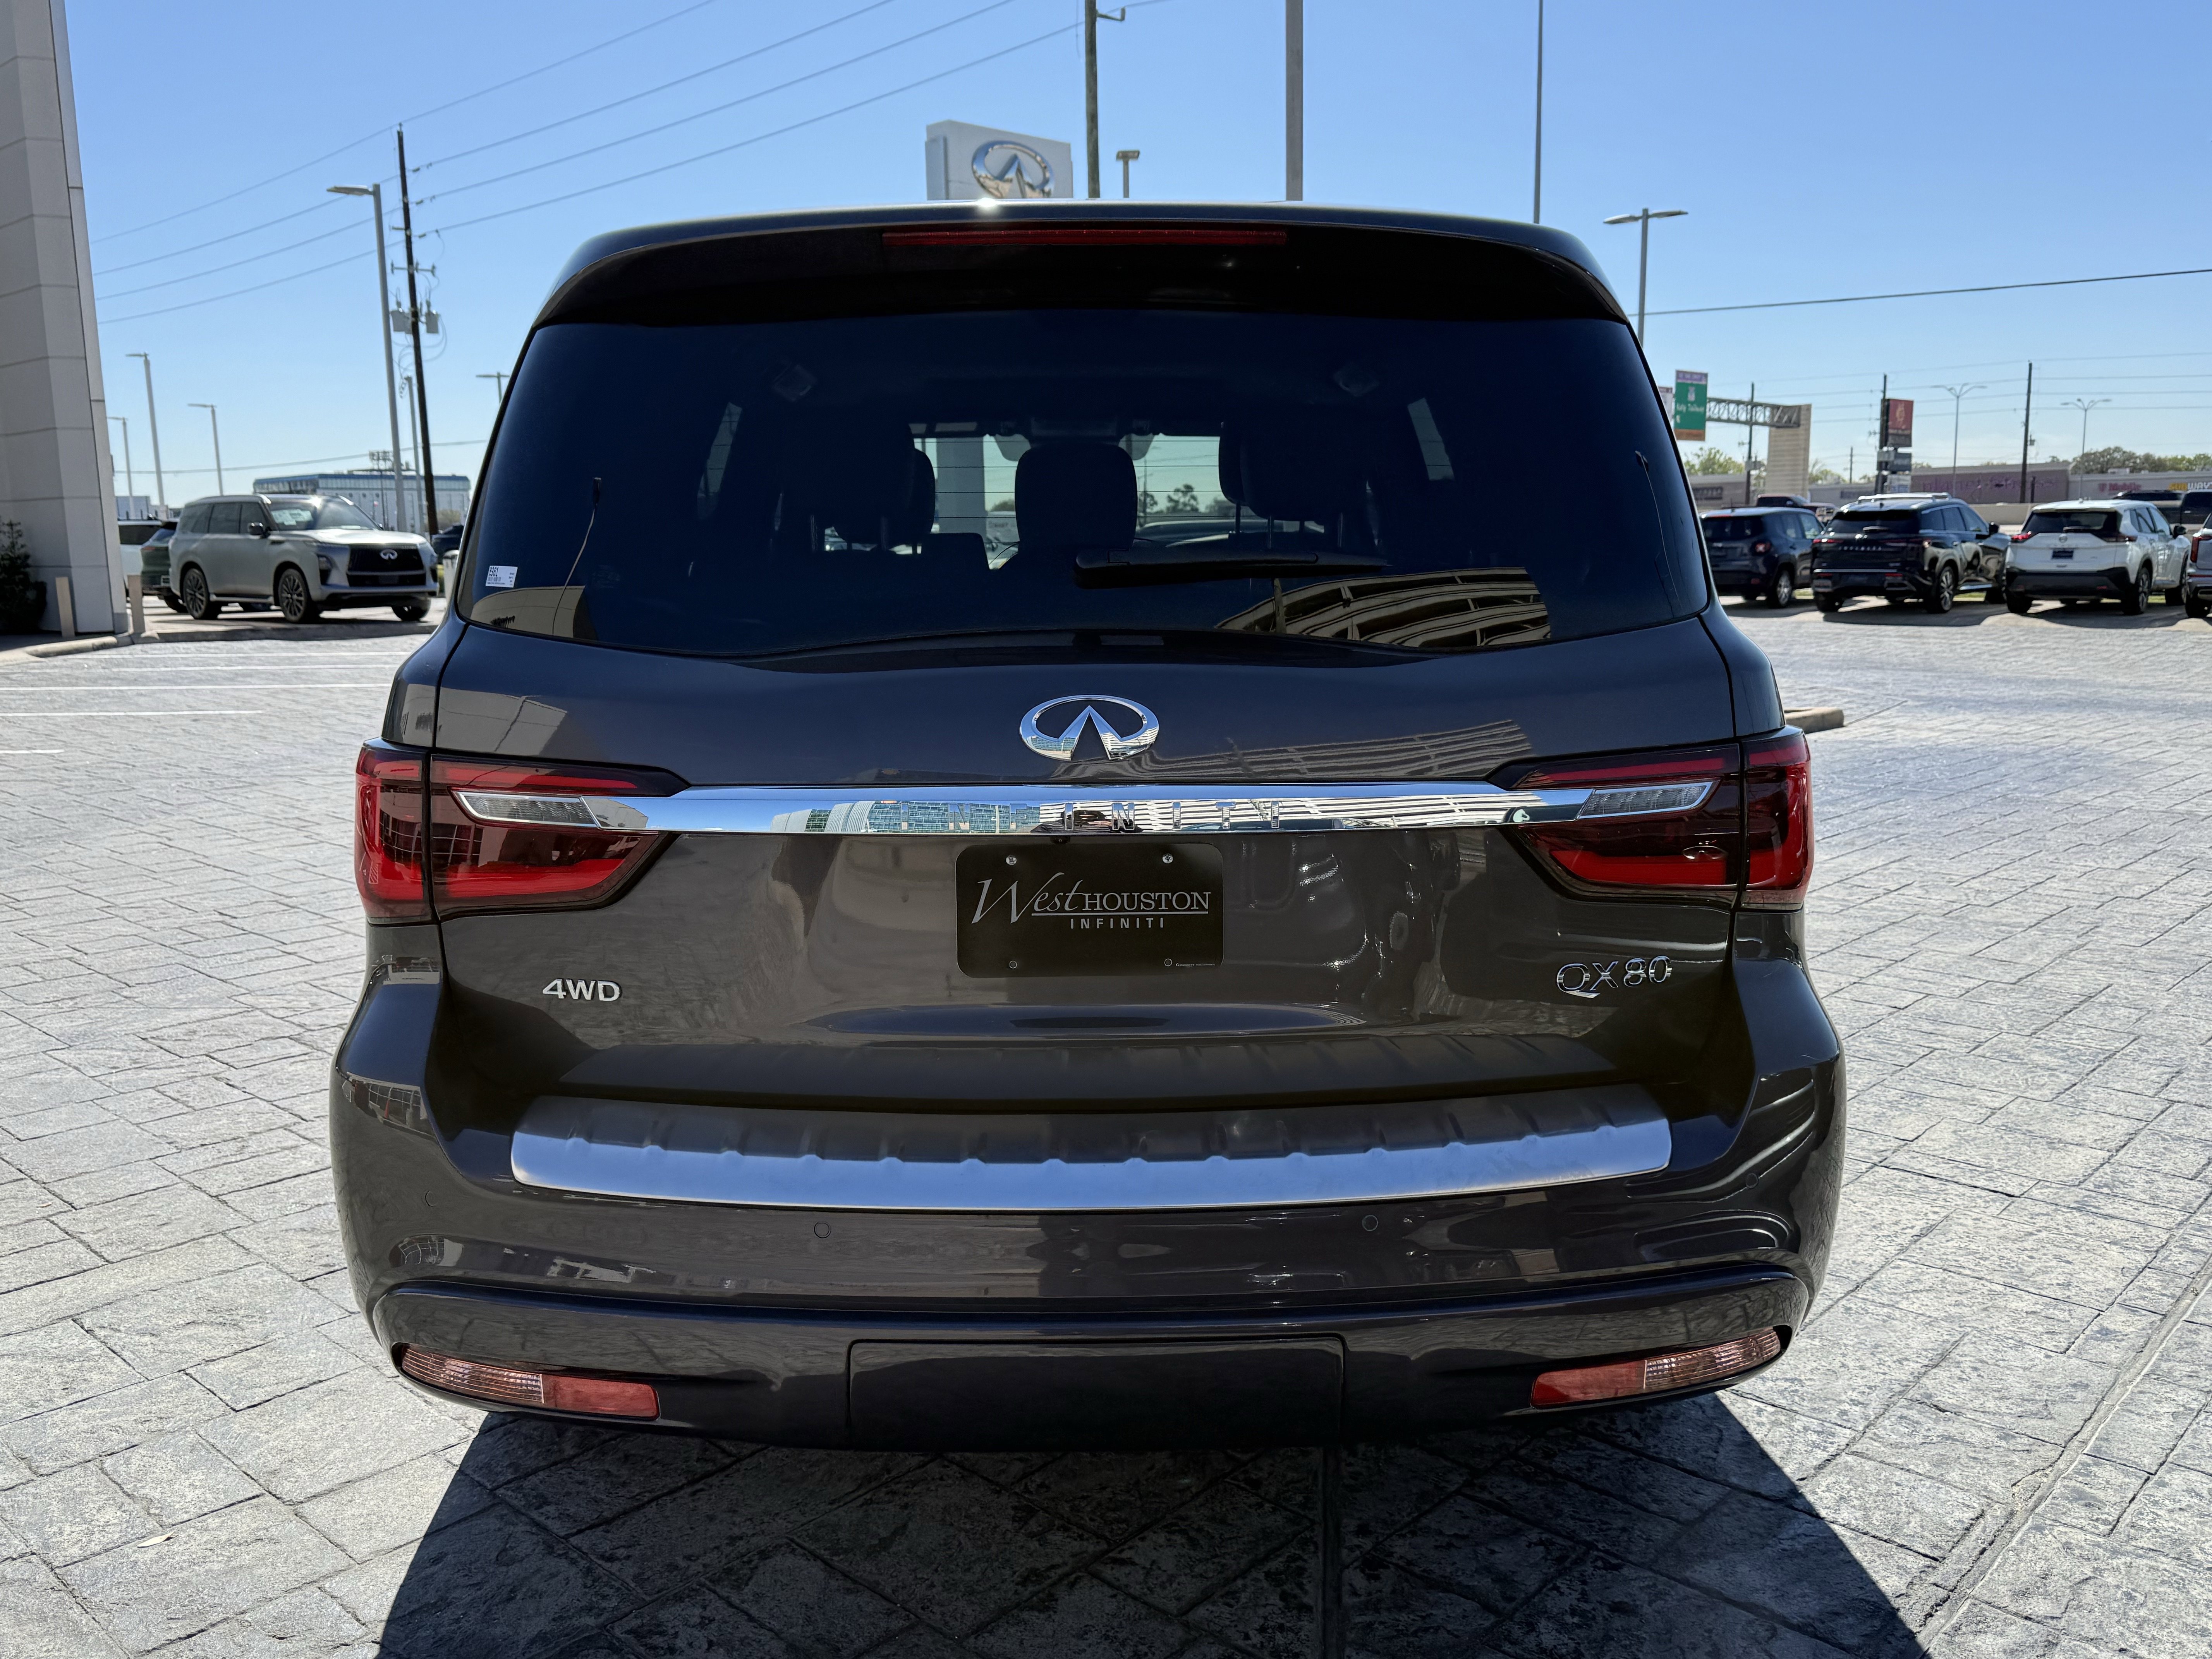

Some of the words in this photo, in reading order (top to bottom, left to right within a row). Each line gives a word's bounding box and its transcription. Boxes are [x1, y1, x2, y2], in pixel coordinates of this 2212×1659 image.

[901, 801, 1279, 831] INFINITI
[971, 872, 1084, 924] West
[1082, 892, 1211, 911] HOUSTON
[1070, 917, 1164, 929] INFINITI
[542, 978, 622, 1002] 4WD
